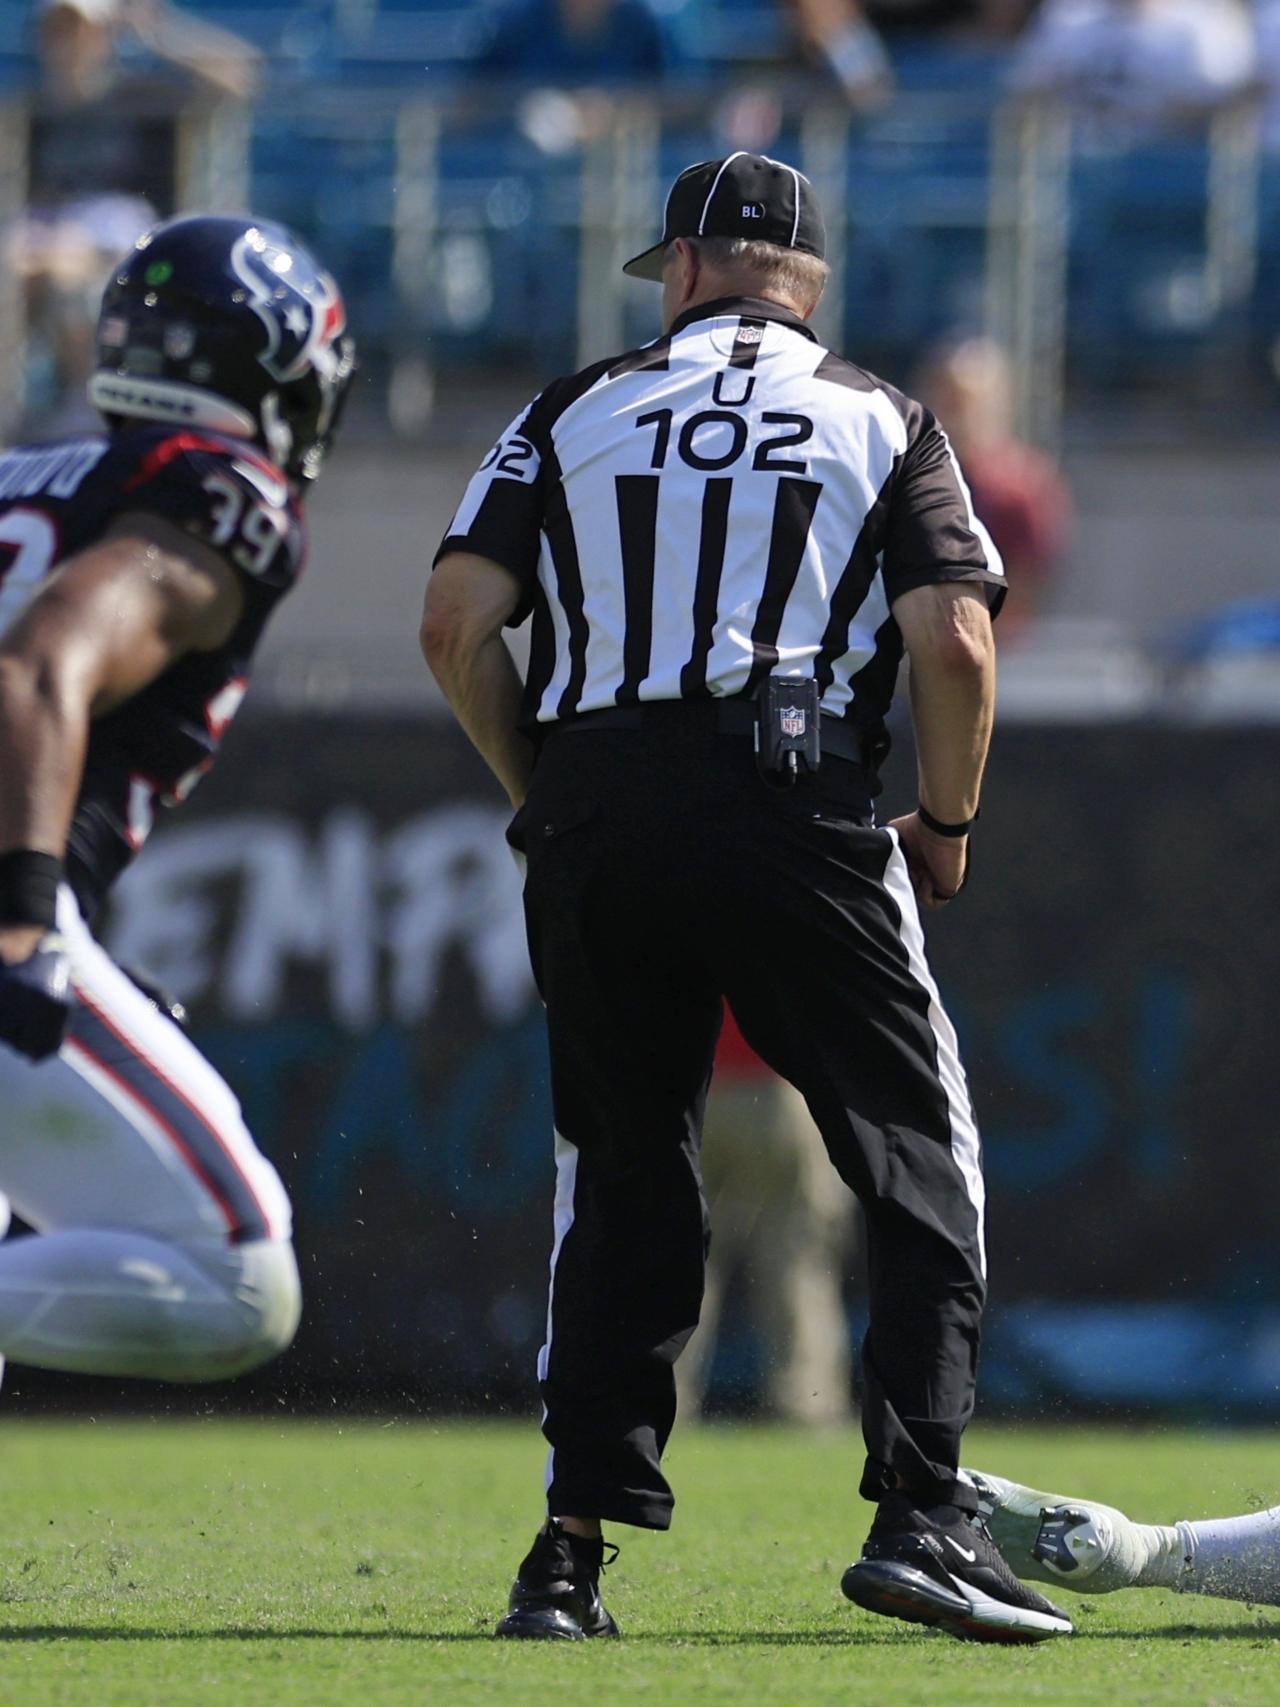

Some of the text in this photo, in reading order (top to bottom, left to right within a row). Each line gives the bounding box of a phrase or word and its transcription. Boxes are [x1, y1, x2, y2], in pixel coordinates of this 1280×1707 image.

[742, 206, 760, 218] BL
[712, 371, 756, 407] U
[635, 408, 814, 475] 102
